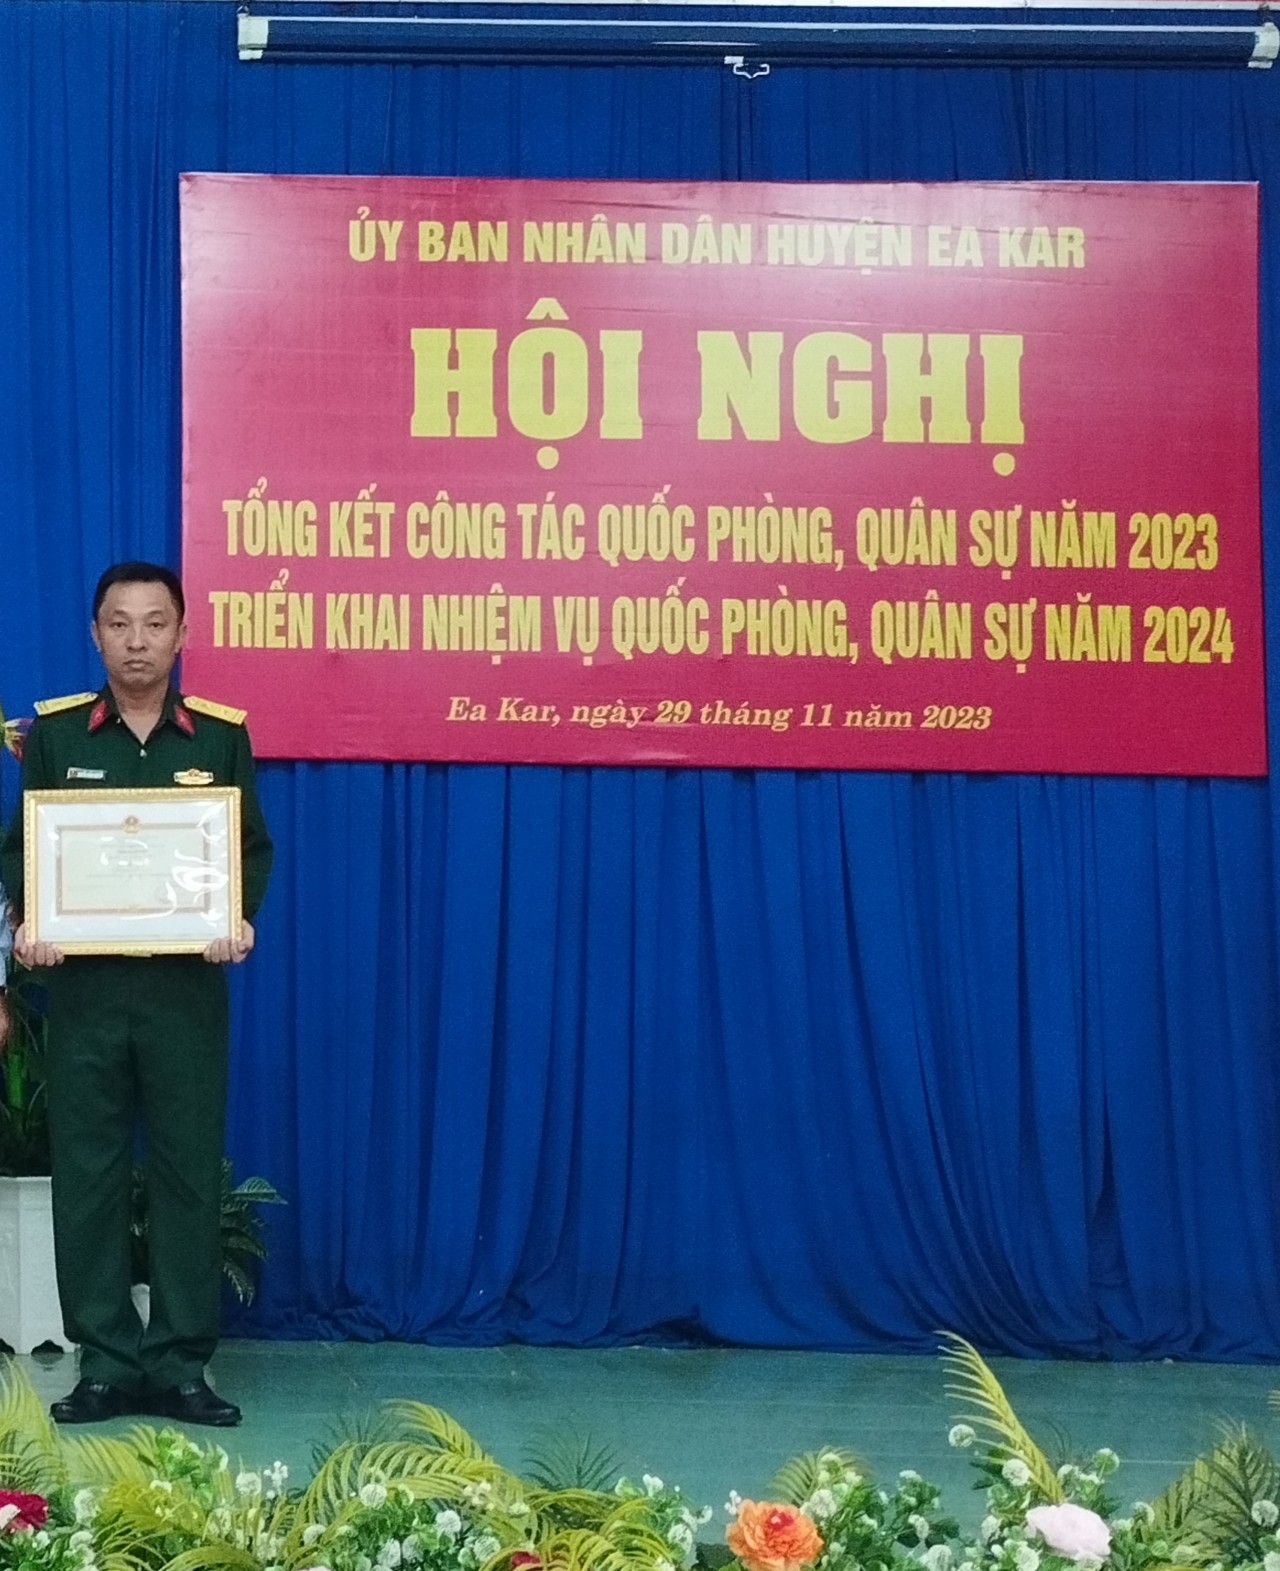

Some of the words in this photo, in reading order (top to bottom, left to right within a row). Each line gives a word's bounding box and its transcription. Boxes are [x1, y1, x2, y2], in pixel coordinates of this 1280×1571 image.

[348, 206, 404, 262] ỦY
[419, 220, 508, 263] BAN
[523, 214, 646, 264] NHÂN
[661, 214, 752, 265] DÂN
[767, 217, 913, 275] HUYỆN
[928, 225, 984, 268] EA
[998, 226, 1086, 269] KAR
[410, 297, 644, 470] HỘI
[696, 330, 1027, 476] NGHỊ
[222, 476, 318, 558] TỔNG
[328, 483, 396, 559] KẾT
[406, 490, 507, 560] CÔNG
[516, 491, 586, 561] TÁC
[598, 484, 696, 568] QUỐC
[707, 492, 844, 572] PHÒNG,
[856, 496, 958, 572] QUÂN
[969, 504, 1022, 580] SỰ
[1030, 499, 1117, 569] NĂM
[1128, 512, 1219, 570] 2023
[209, 568, 314, 650] TRIỂN
[325, 593, 411, 651] KHAI
[422, 582, 542, 666] NHIỆM
[552, 596, 600, 667] VỤ
[612, 576, 710, 661] QUỐC
[722, 584, 859, 666] PHÒNG,
[870, 589, 973, 665] QUÂN
[984, 597, 1037, 673] SỰ
[1045, 592, 1132, 663] NĂM
[1142, 606, 1235, 664] 2024
[446, 697, 487, 722] Ea
[496, 697, 561, 727] Kar,
[570, 698, 644, 728] ngày
[655, 700, 693, 724] 29
[699, 700, 793, 732] tháng
[800, 703, 834, 727] 11
[843, 703, 913, 729] năm
[920, 705, 993, 731] 2023
